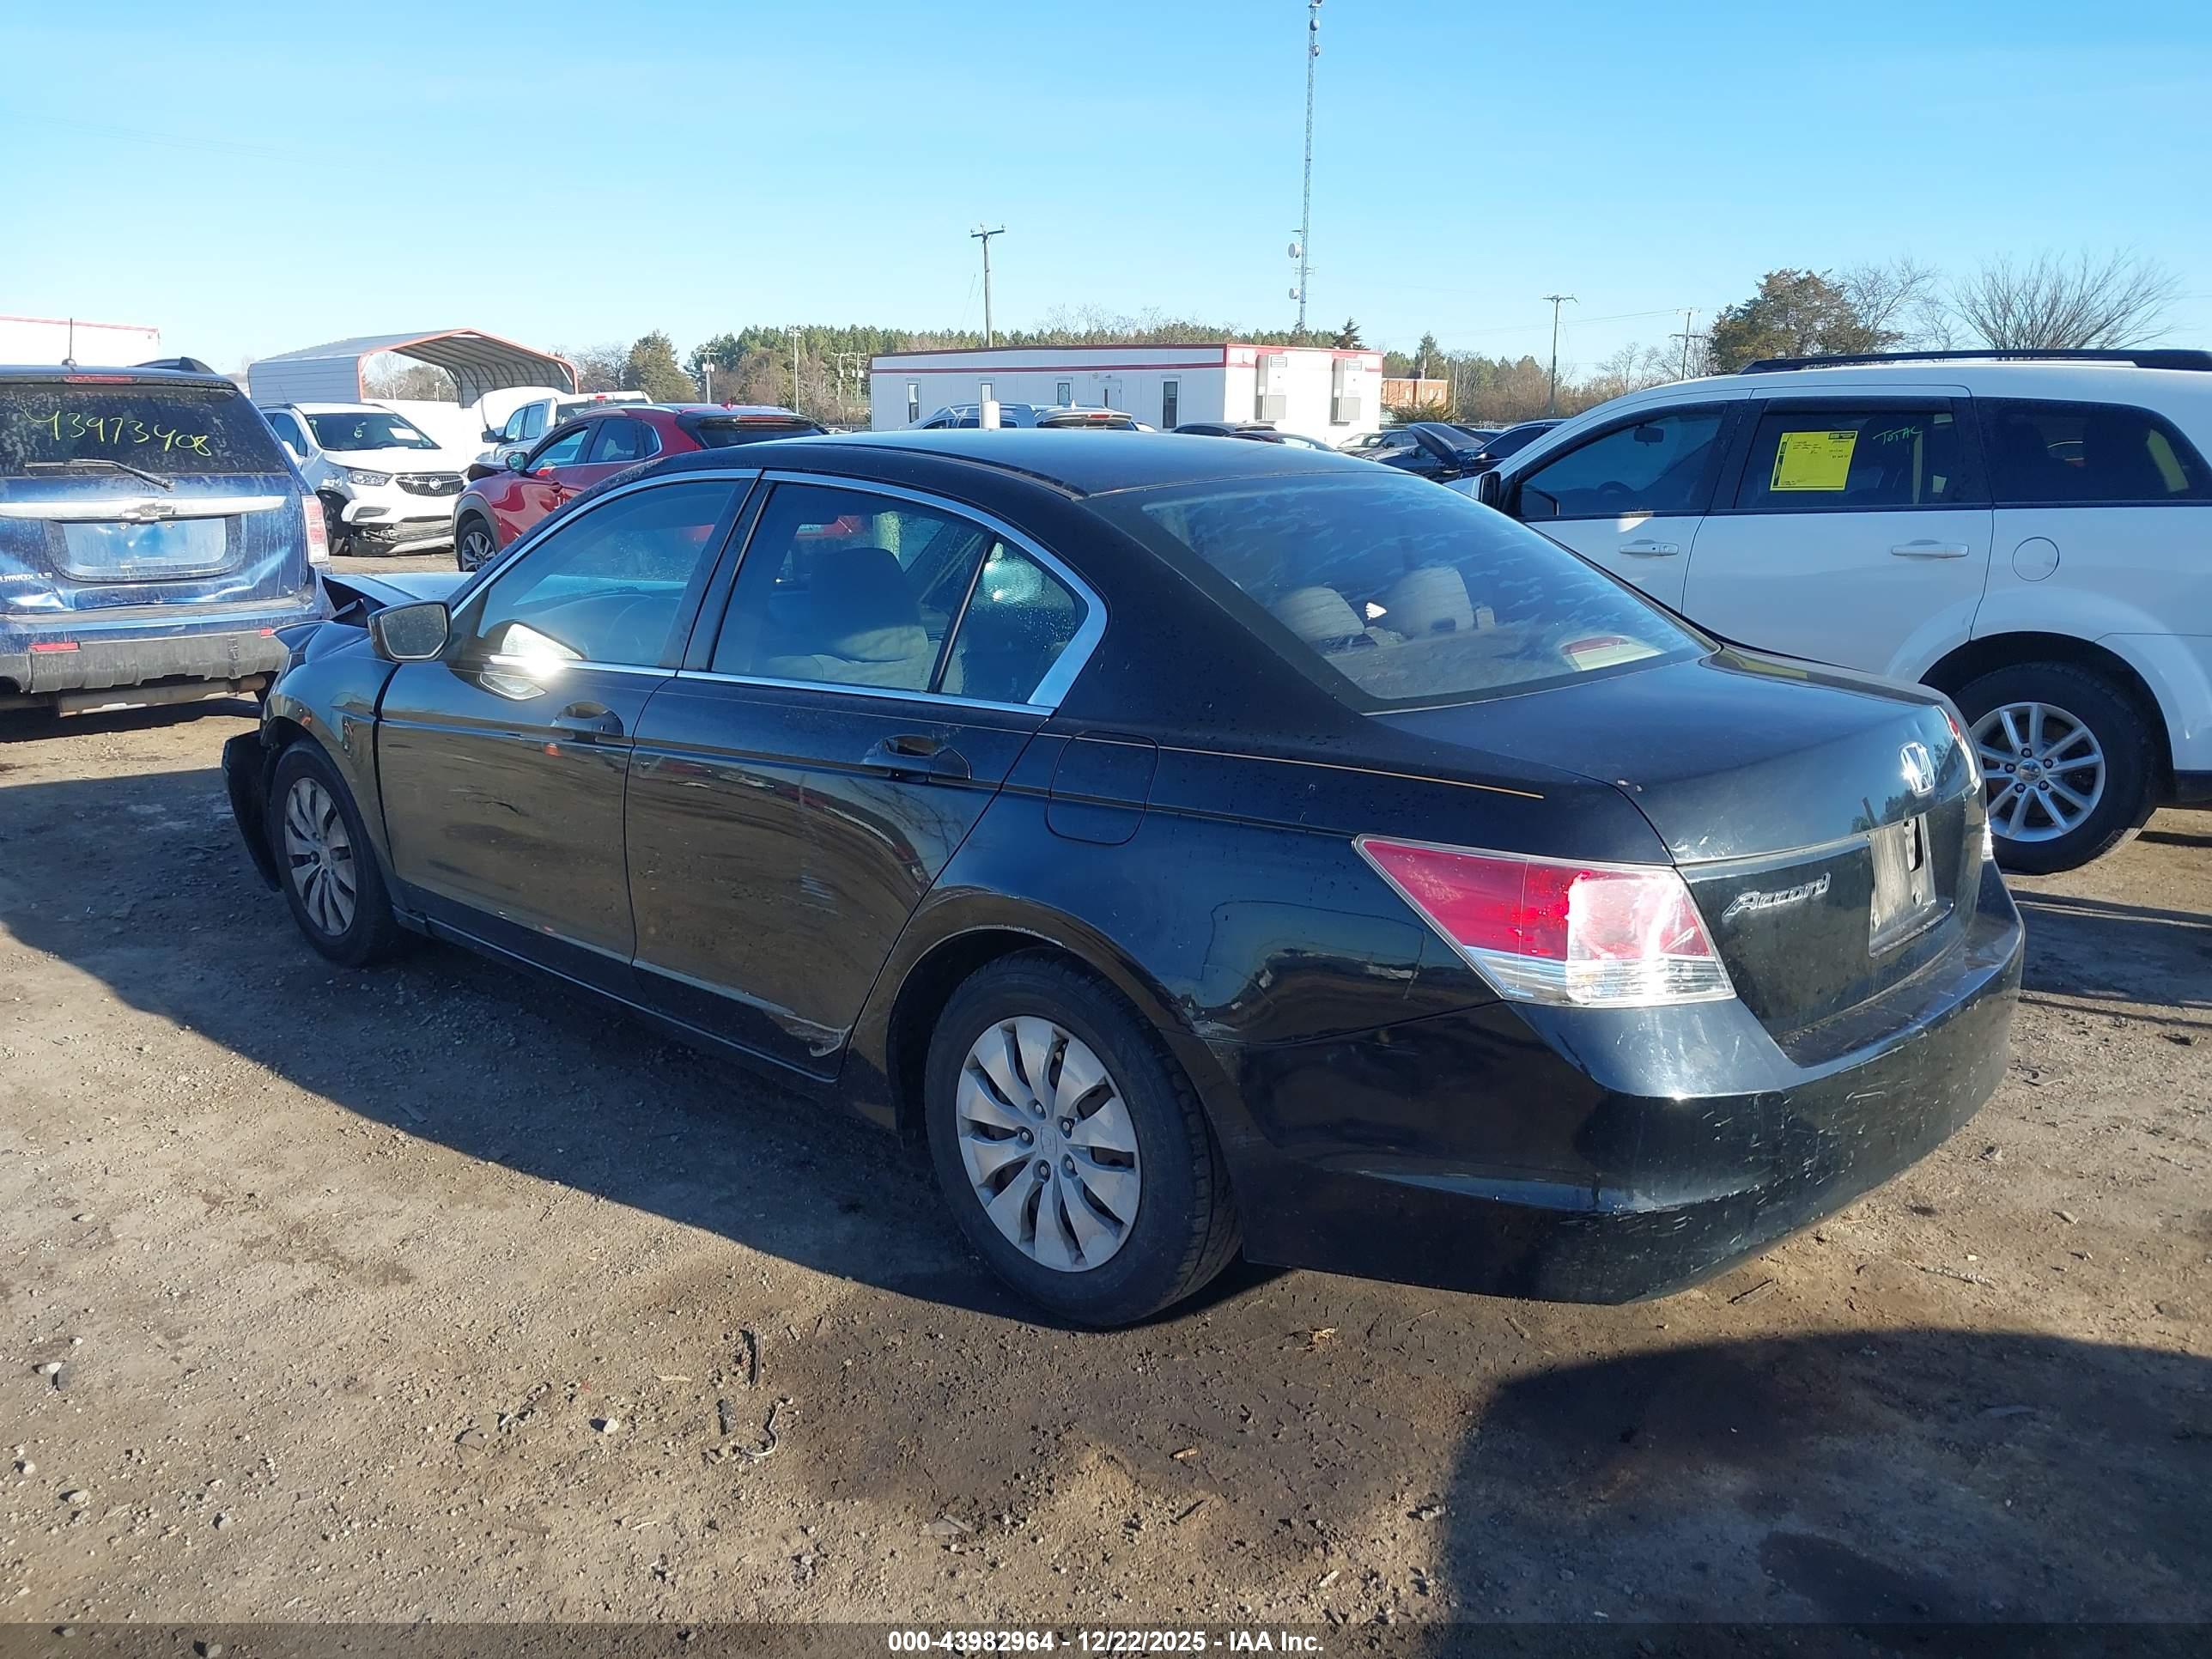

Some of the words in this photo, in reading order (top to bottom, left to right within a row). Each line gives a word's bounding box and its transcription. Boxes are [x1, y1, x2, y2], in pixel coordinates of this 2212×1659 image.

[24, 407, 212, 457] 43973408
[38, 571, 53, 580] LS
[1721, 872, 1832, 923] Accord
